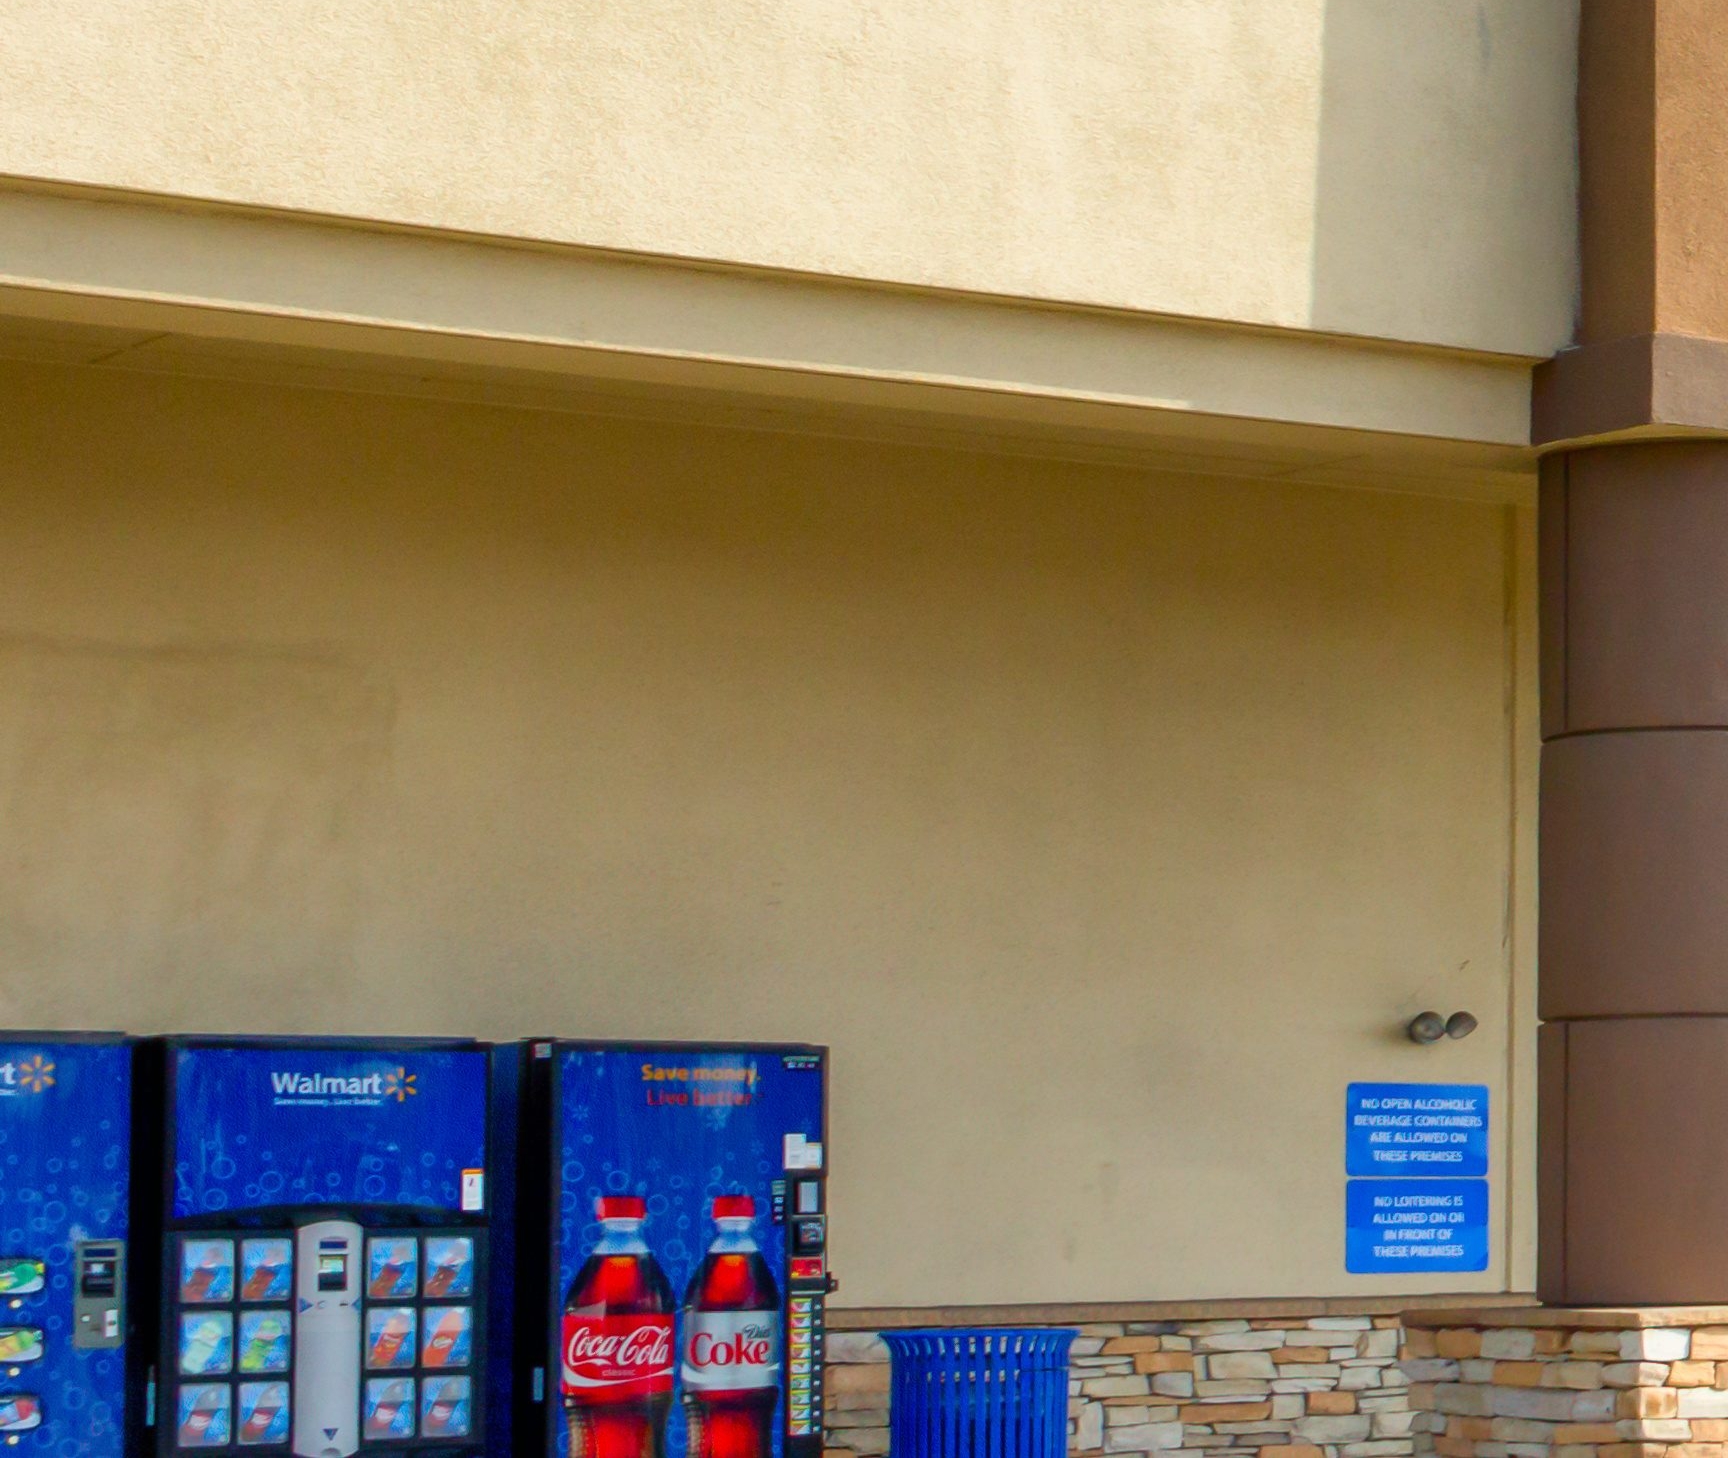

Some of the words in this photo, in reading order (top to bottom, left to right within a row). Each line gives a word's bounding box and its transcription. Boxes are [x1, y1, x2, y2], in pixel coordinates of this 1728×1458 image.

[641, 1063, 689, 1081] Save
[693, 1066, 761, 1086] money.
[271, 1071, 382, 1094] Walmart
[647, 1089, 688, 1106] Live
[1361, 1098, 1380, 1110] NO
[1381, 1098, 1412, 1110] OPEN
[1414, 1099, 1477, 1111] ALCOHOLIC
[1353, 1114, 1413, 1127] BEVERAGE
[1414, 1115, 1483, 1128] CONTAINERS
[1369, 1131, 1392, 1143] ARE
[1393, 1131, 1449, 1144] ALLOWED
[1450, 1132, 1468, 1143] ON
[1373, 1150, 1409, 1162] THESE
[1410, 1150, 1463, 1162] PREMISES
[1374, 1196, 1393, 1207] NO
[1394, 1196, 1452, 1208] LOITERING
[1454, 1196, 1463, 1207] IS
[1372, 1212, 1428, 1224] ALLOWED
[1429, 1212, 1447, 1223] ON
[1448, 1212, 1465, 1223] OR
[1383, 1229, 1397, 1241] IN
[1398, 1228, 1436, 1241] FRONT
[1437, 1228, 1453, 1241] OF
[1373, 1245, 1409, 1258] THESE
[1410, 1244, 1464, 1257] PREMISES
[743, 1323, 772, 1340] Diet
[568, 1325, 671, 1367] Coca-Cola
[690, 1332, 769, 1367] Coke
